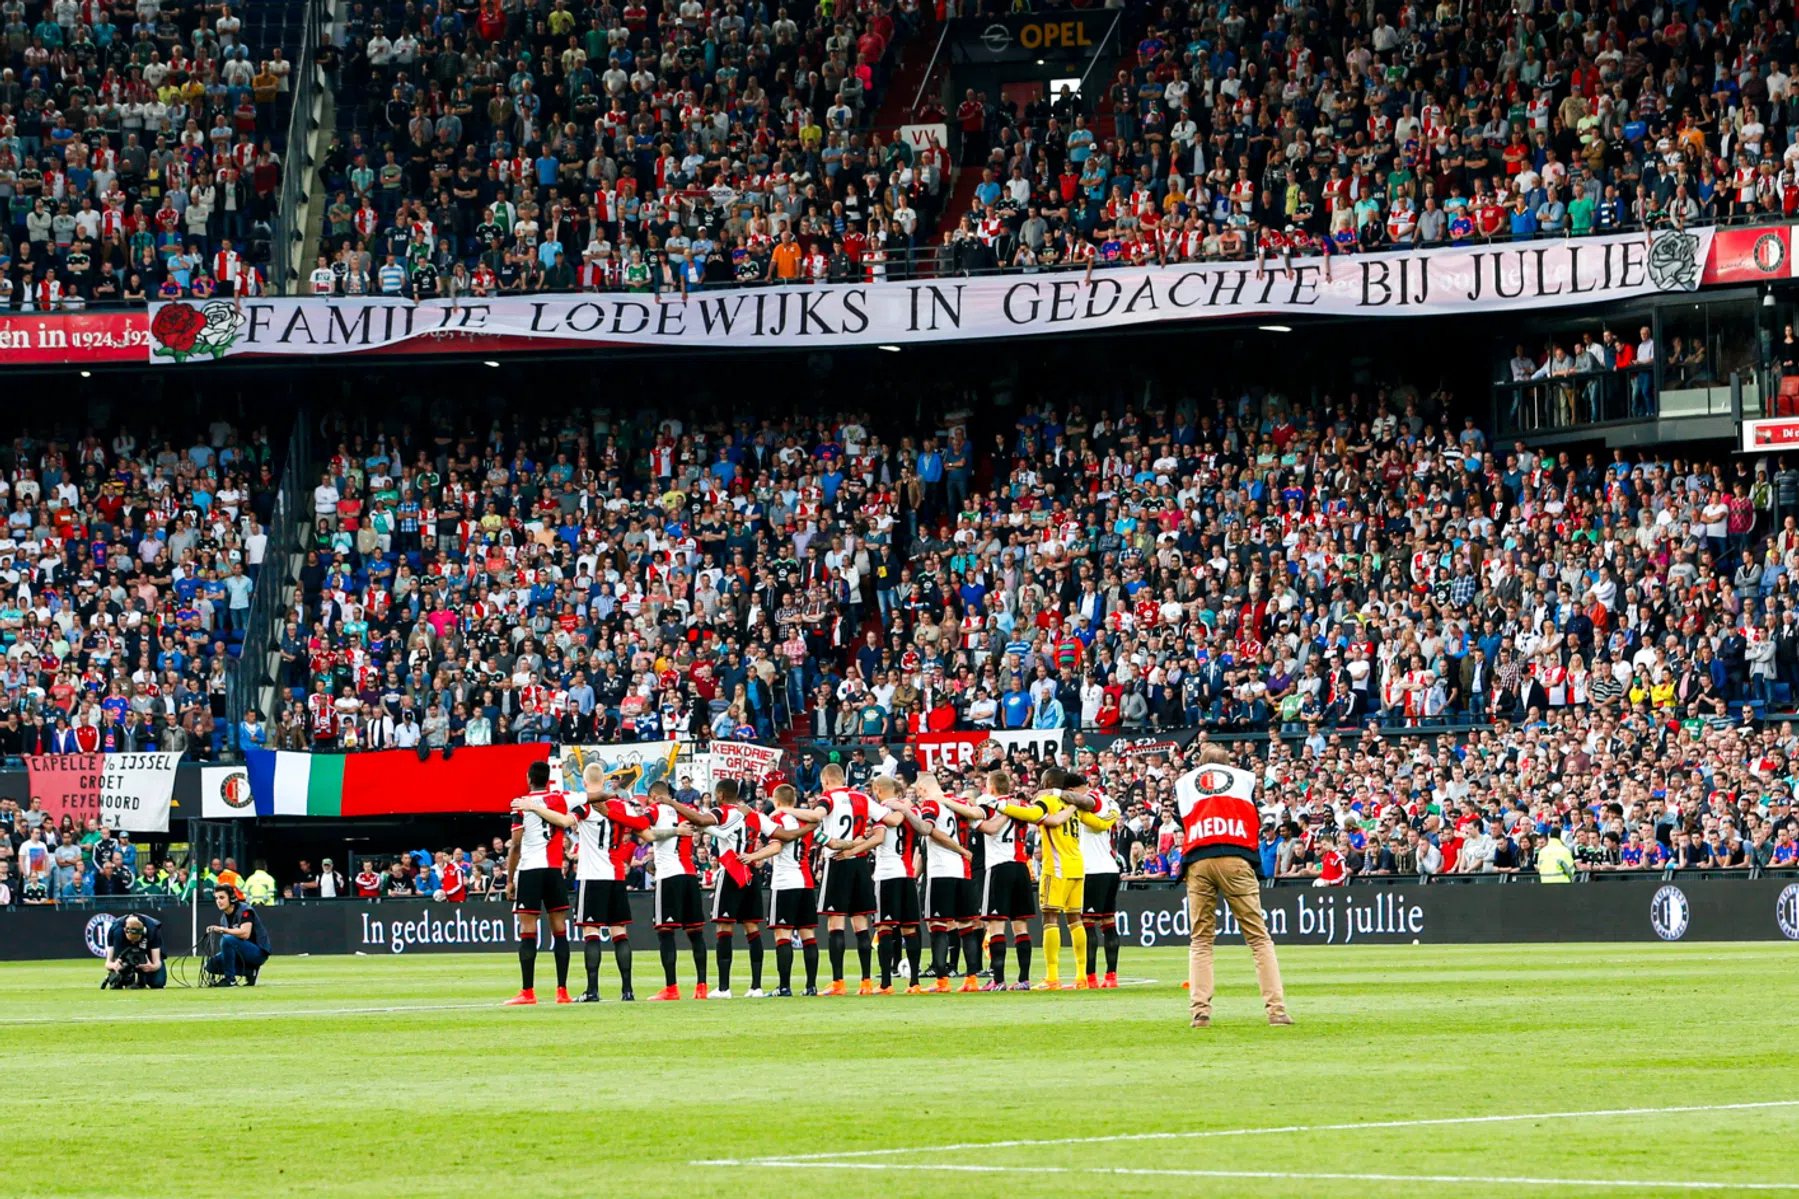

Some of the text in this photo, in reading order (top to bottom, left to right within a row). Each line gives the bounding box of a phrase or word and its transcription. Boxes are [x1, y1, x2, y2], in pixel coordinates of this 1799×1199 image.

[1020, 21, 1092, 48] OPEL
[529, 288, 869, 337] LODEWIJKS
[906, 285, 967, 331] IN
[1003, 265, 1320, 325] GEDACHTE
[1356, 256, 1431, 306] BIJ
[1466, 241, 1646, 302] JULLIE
[38, 322, 68, 348] in
[31, 755, 96, 771] CAPELLE
[120, 755, 171, 770] IJSSEL
[726, 757, 766, 773] GROET
[919, 742, 975, 772] TER
[1006, 740, 1059, 766] AAR
[80, 775, 124, 790] GROET
[62, 794, 140, 810] FEYENOORD
[1188, 816, 1248, 844] MEDIA
[361, 912, 384, 944] In
[391, 908, 505, 953] gedachten
[1114, 892, 1423, 947] n gedchen bij jullie
